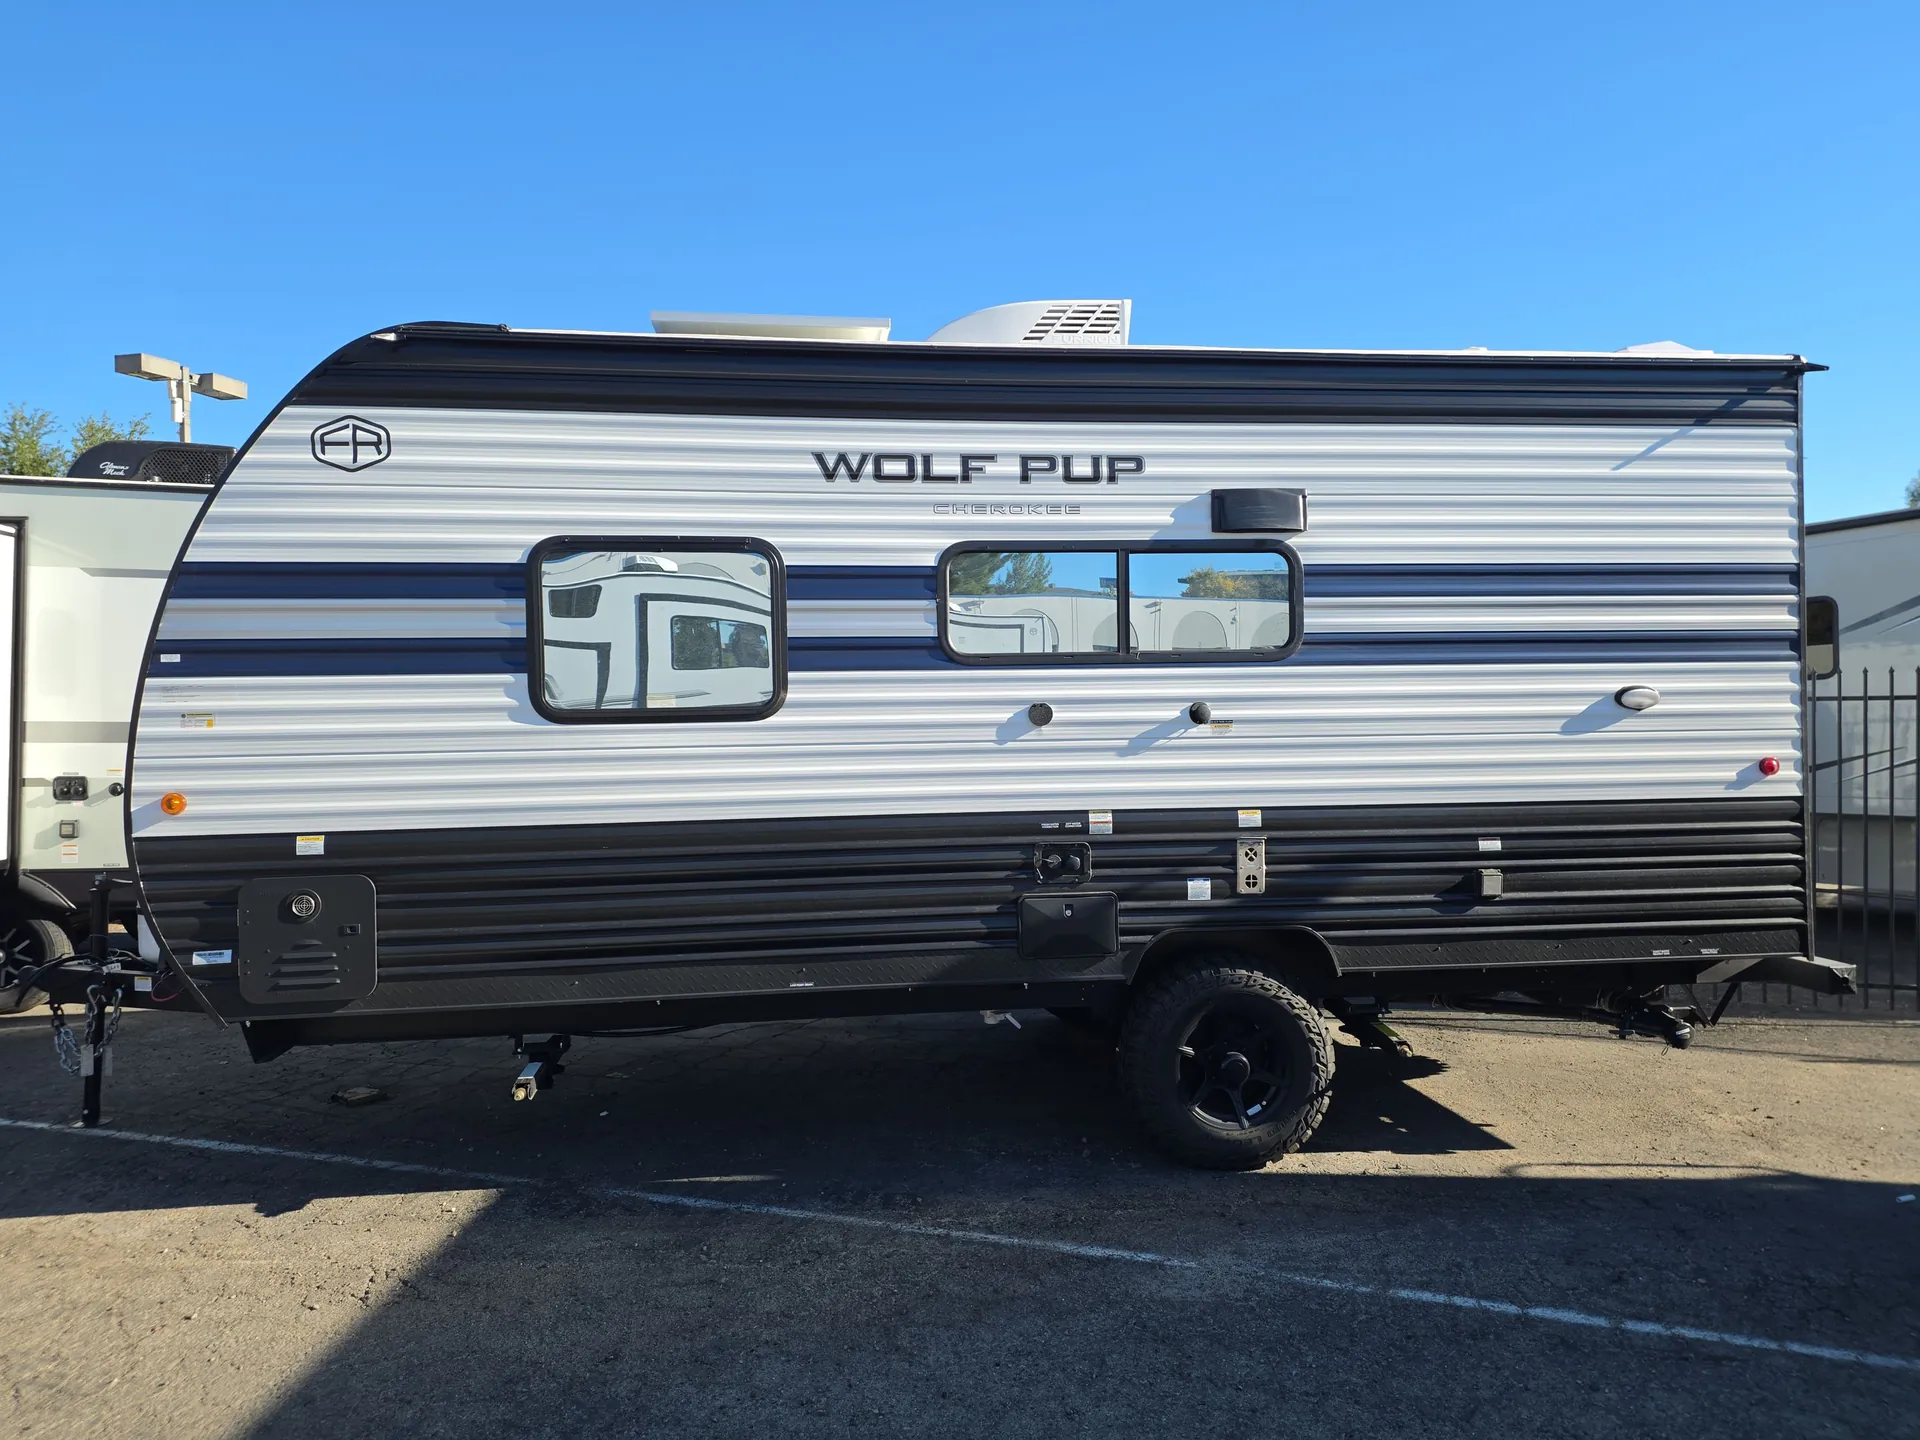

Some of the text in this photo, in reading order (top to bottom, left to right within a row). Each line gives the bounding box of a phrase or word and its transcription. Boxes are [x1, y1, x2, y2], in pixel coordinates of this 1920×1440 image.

[1051, 334, 1118, 344] FURRION
[810, 451, 1146, 485] WOLF PUP
[932, 503, 1082, 515] CHEROKEE
